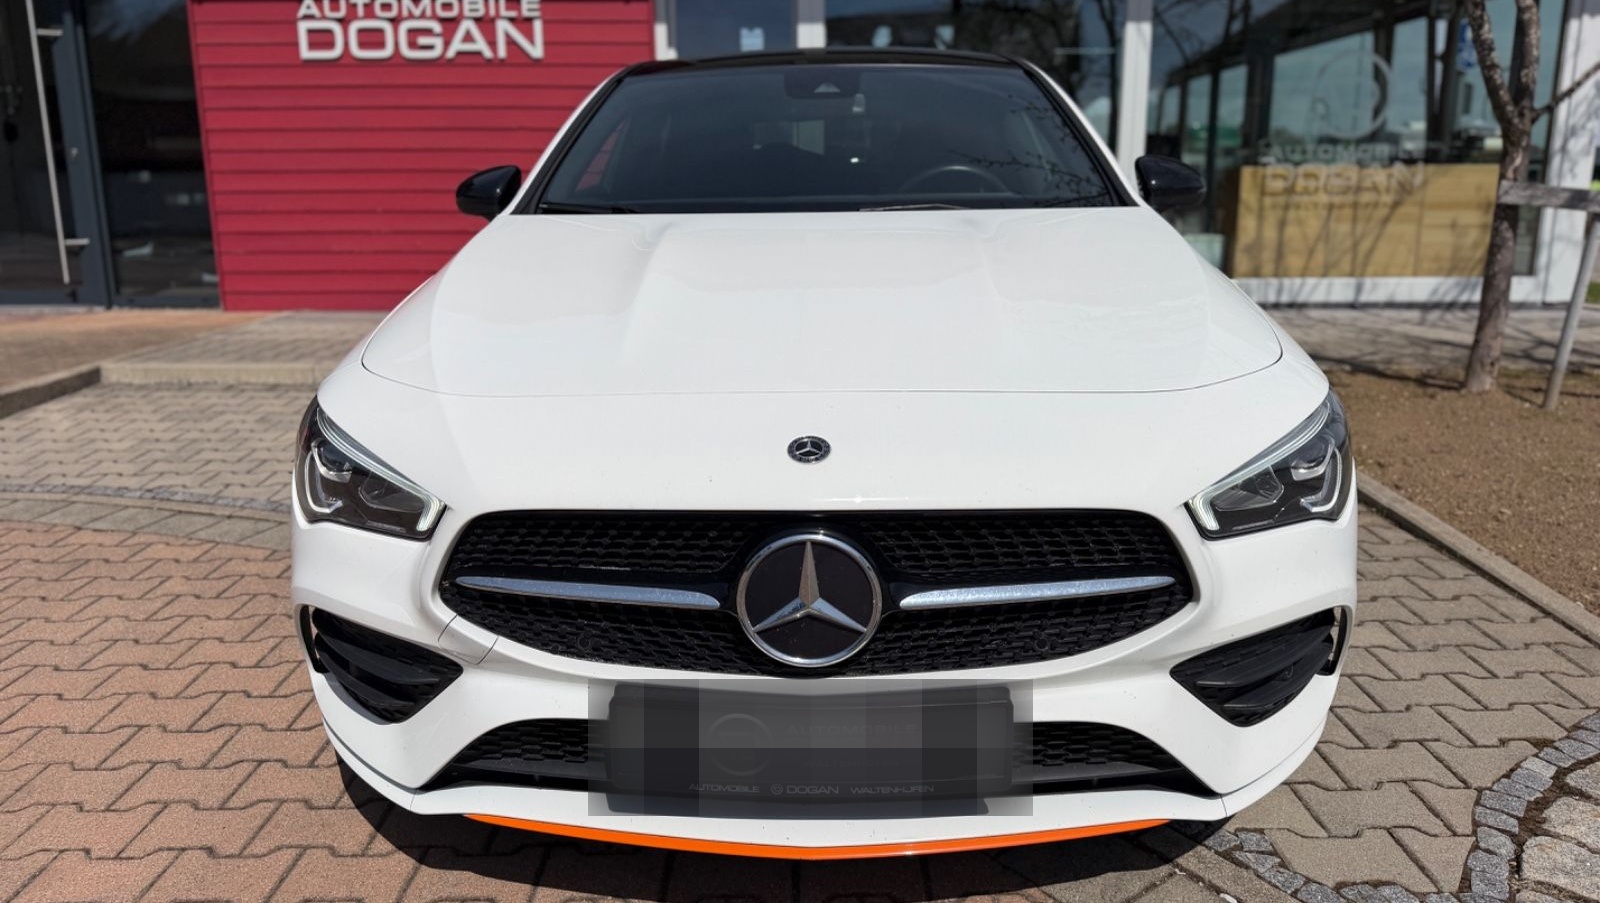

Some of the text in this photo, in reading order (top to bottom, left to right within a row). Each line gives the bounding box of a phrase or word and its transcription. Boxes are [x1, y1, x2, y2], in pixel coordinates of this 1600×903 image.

[297, 0, 541, 19] AUTOMOBILE
[297, 19, 544, 60] DOGAN
[1264, 162, 1425, 195] DOGAN
[786, 724, 918, 735] AUTOMOBILE
[688, 783, 760, 793] AUTOMOBILE
[786, 785, 839, 794] DOGAN
